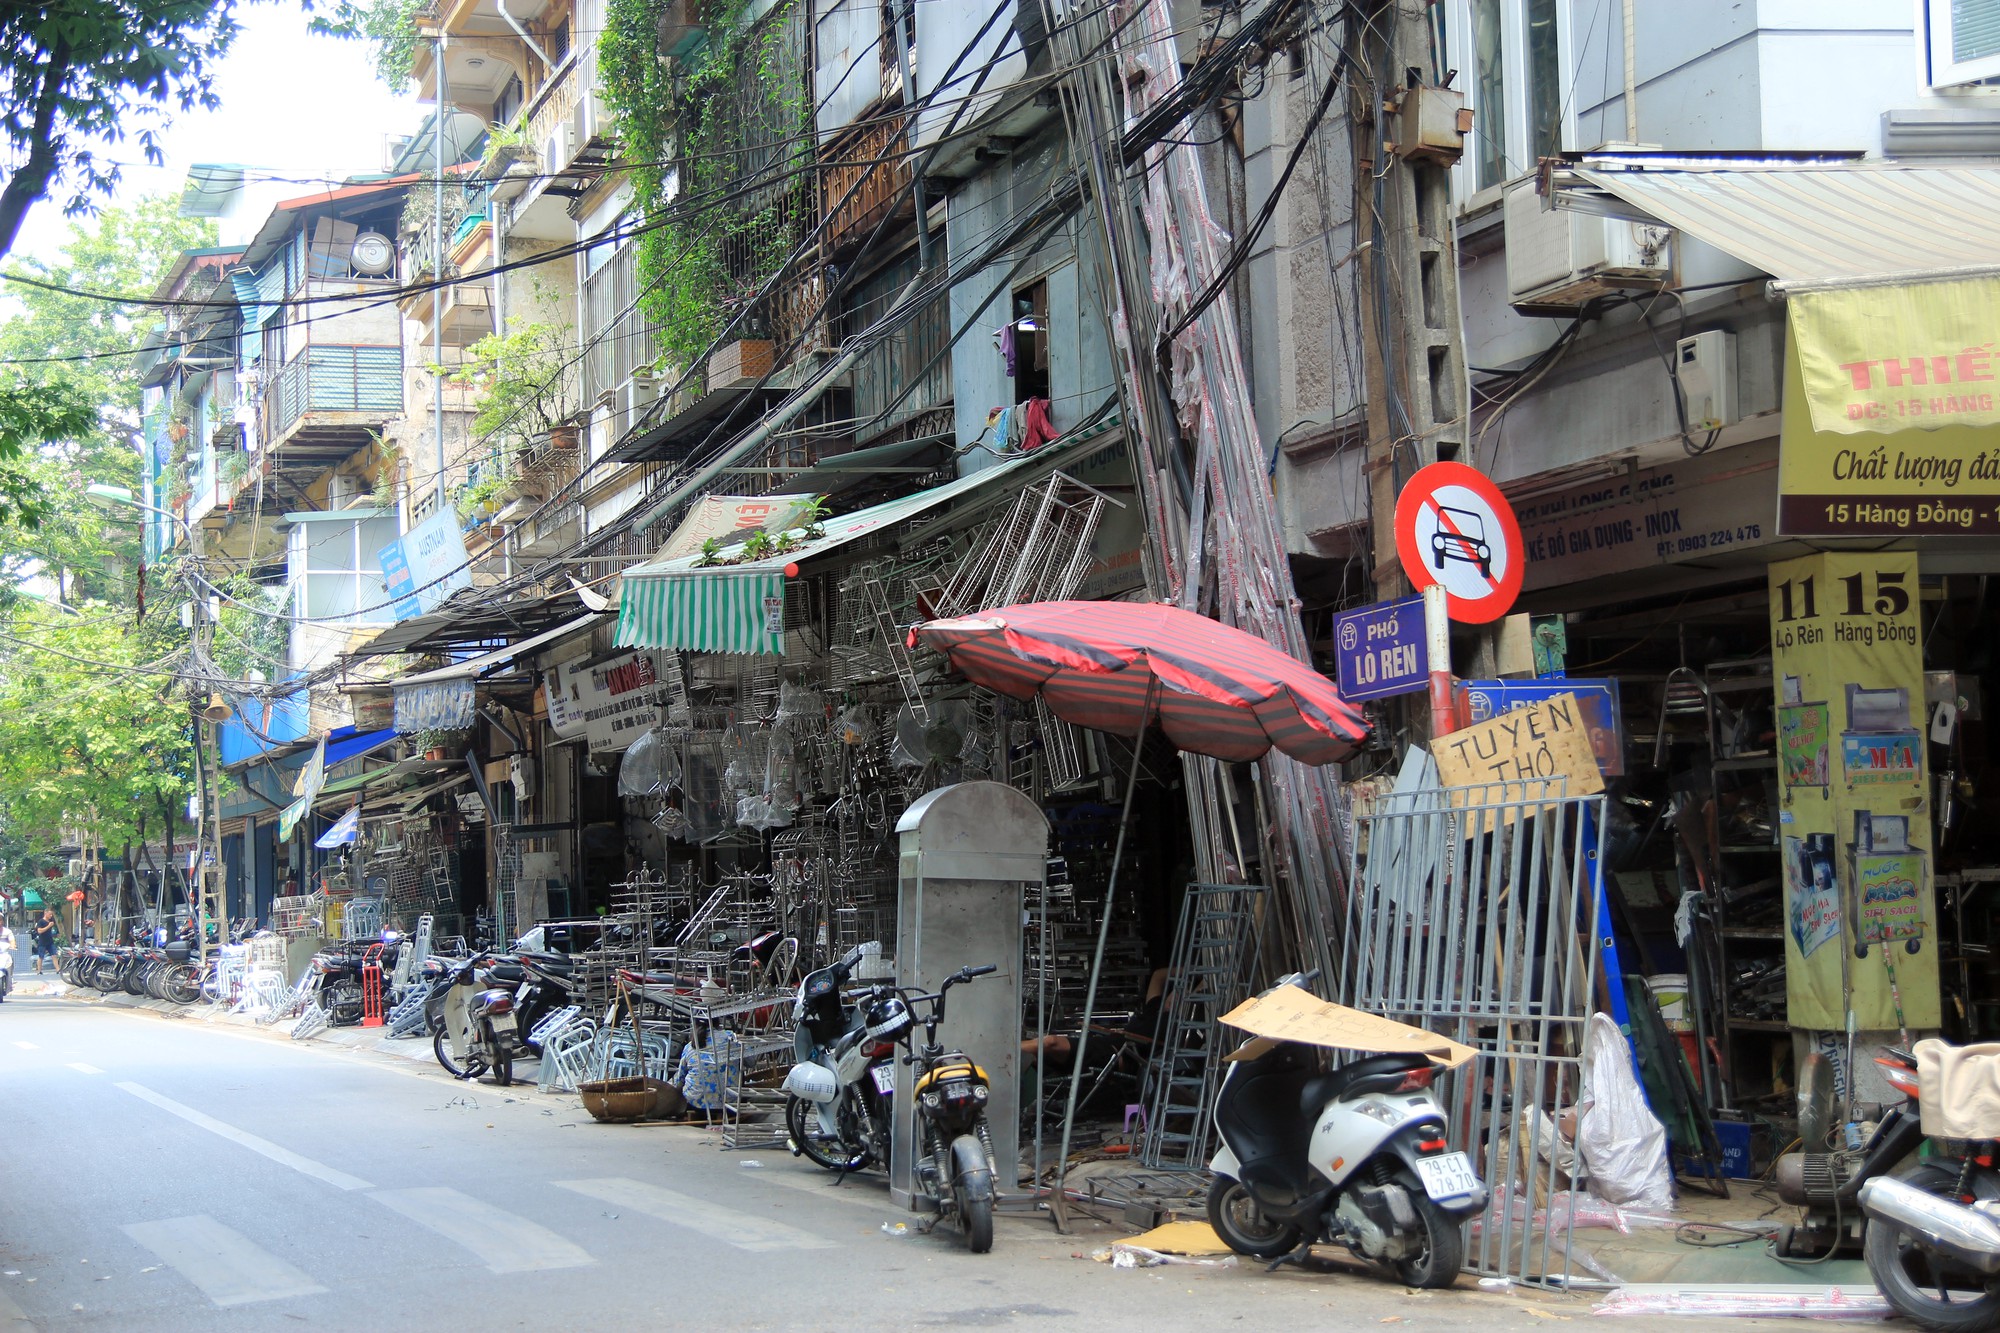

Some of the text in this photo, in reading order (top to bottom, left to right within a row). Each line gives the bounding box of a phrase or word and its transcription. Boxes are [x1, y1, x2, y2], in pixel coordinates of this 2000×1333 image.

[1839, 343, 2000, 391] THIẾ
[1846, 401, 1888, 421] ĐC:
[1894, 399, 1923, 417] 15
[1929, 393, 1994, 415] HÀNG
[1832, 445, 2000, 488] Chất lượng đả
[1824, 503, 1849, 523] 15
[1855, 502, 1910, 528] Hàng
[1916, 500, 1973, 528] Đồng
[1569, 529, 1592, 554] GIA
[1595, 521, 1634, 551] DỤNG
[1646, 508, 1682, 538] INOX
[1677, 534, 1707, 553] 0903
[1710, 530, 1733, 547] 224
[1776, 573, 1820, 623] 11
[1837, 569, 1910, 616] 15
[1366, 611, 1399, 641] PHỐ
[1775, 623, 1824, 648] Lò Rèn
[1834, 617, 1917, 647] Hàng Đồng
[1355, 639, 1417, 686] LÒ RÈN
[1425, 1155, 1464, 1177] 29-C1
[1722, 1147, 1742, 1158] AND
